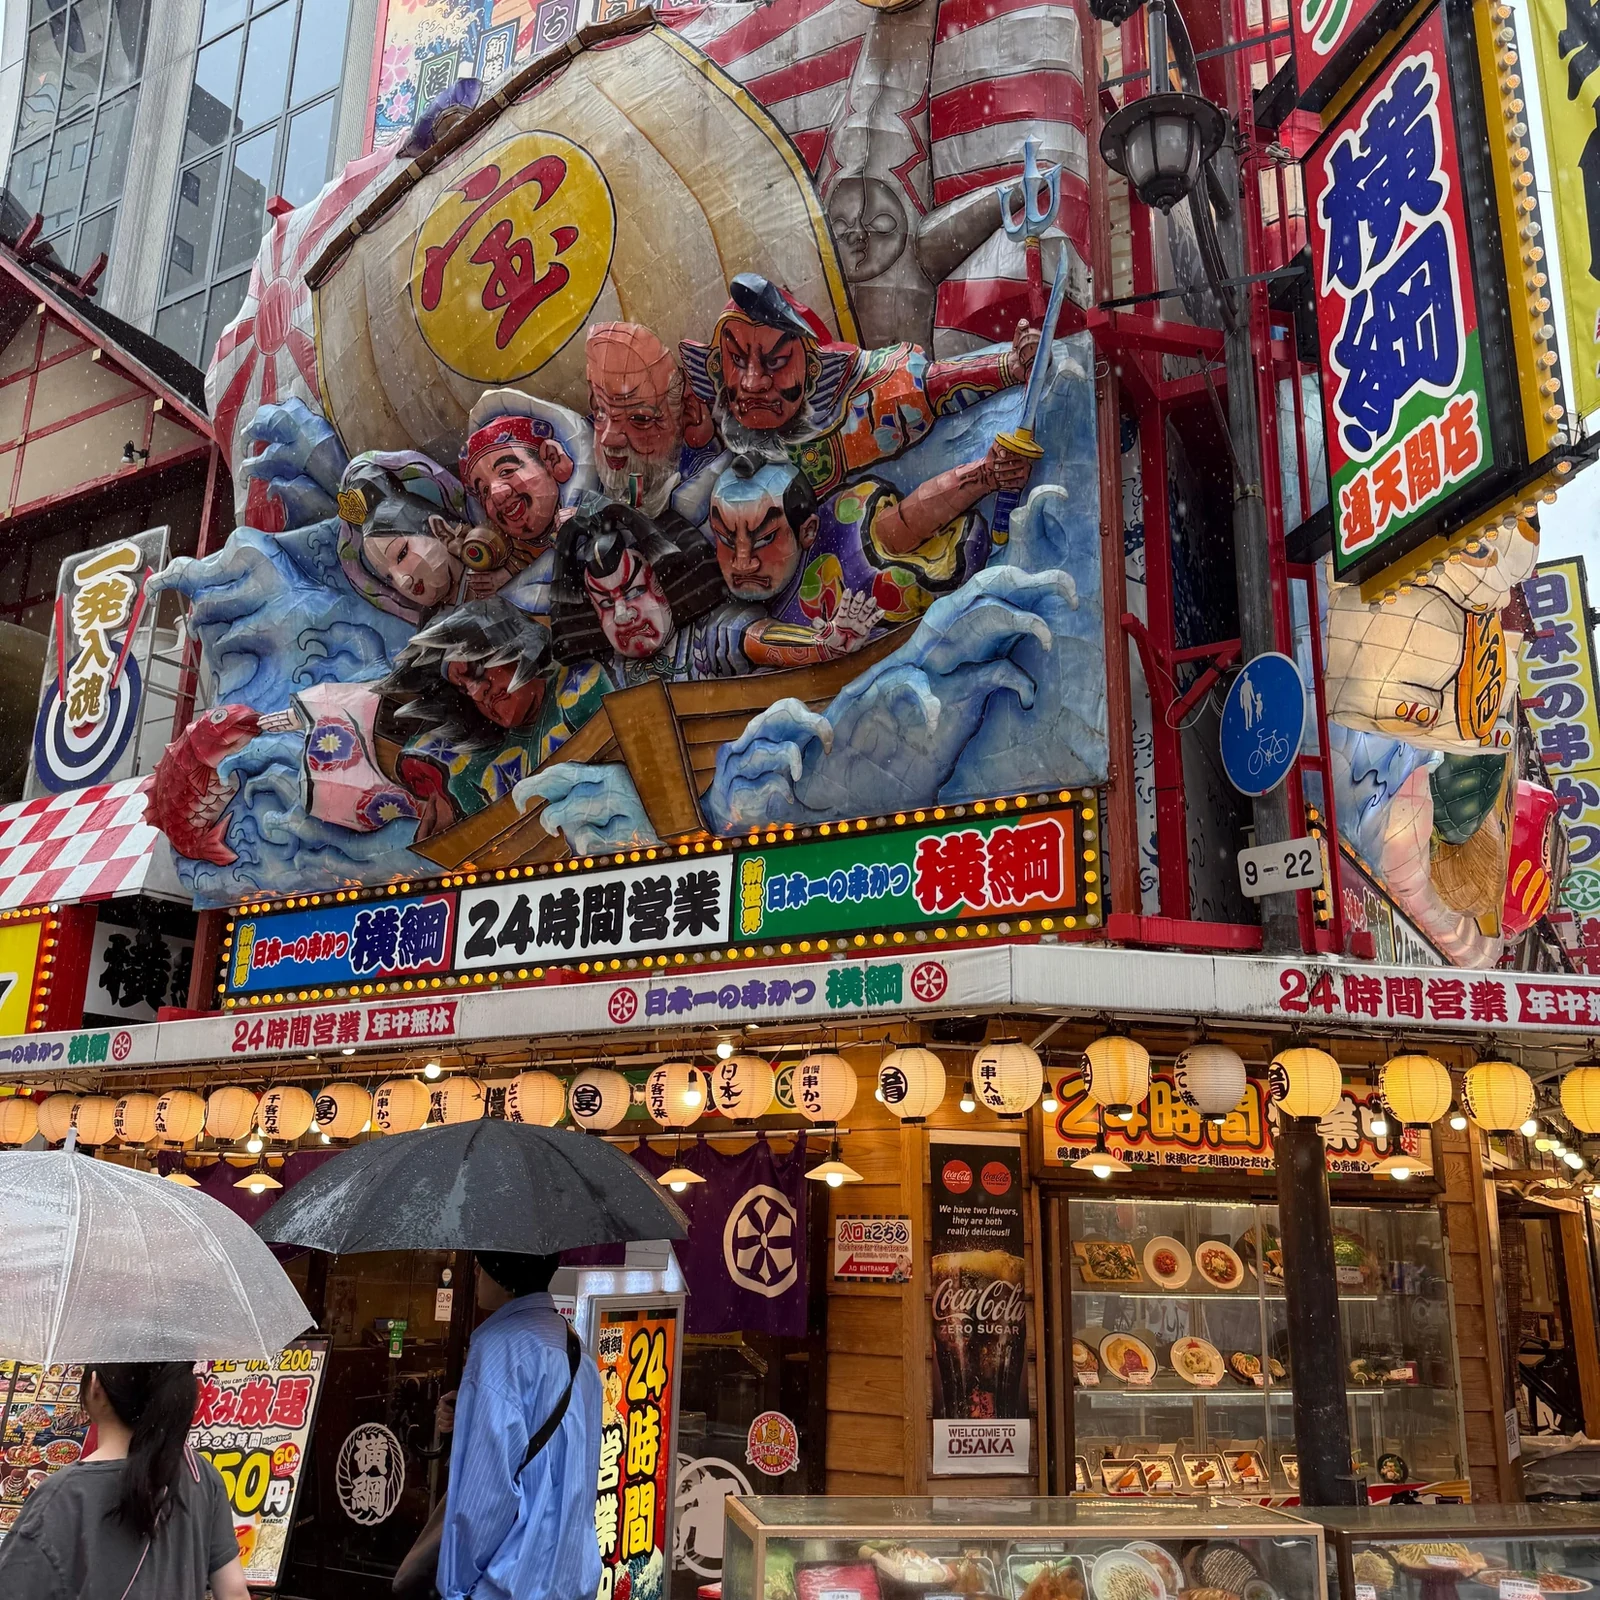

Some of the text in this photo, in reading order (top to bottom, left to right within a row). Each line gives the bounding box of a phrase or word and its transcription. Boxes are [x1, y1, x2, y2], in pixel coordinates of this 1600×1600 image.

[1322, 62, 1458, 452] 横綱
[1343, 398, 1478, 549] 通天閣店
[69, 546, 141, 719] 一発入魂
[1521, 572, 1600, 866] 日本一の串かつ
[767, 863, 911, 913] 日本一の串かつ
[914, 819, 1064, 914] 横綱
[464, 870, 721, 960] 24時間営業
[742, 857, 764, 934] 新世界
[234, 924, 254, 987] 新世界
[252, 930, 348, 969] 日本一の串かつ
[350, 899, 449, 973] 横綱
[644, 963, 904, 1016] 日本一の串かつ 横綱
[1279, 968, 1509, 1023] 24時間営業
[68, 1032, 110, 1064] 横綱
[231, 1004, 451, 1053] 24時間営業 年中無休
[575, 1087, 601, 1113] 宴
[650, 1070, 668, 1119] 千客万来
[719, 1063, 744, 1110] 日本一
[802, 1075, 821, 1113] 串かつ
[980, 1059, 1005, 1107] 一串入魂
[1175, 1053, 1199, 1107] どて焼
[154, 1097, 170, 1133] 一串入魂
[264, 1094, 281, 1135] 千客万来
[315, 1099, 336, 1123] 宴
[376, 1097, 391, 1129] 串かつ
[506, 1081, 524, 1124] どて焼
[939, 1205, 1018, 1216] We have two flavors,
[947, 1227, 1010, 1237] really delicious!!
[952, 1216, 969, 1226] they
[984, 1217, 1002, 1226] both
[838, 1221, 909, 1244] 入口はこちら
[932, 1278, 1025, 1322] Coca-Cola
[599, 1335, 623, 1355] 横綱
[940, 1325, 1020, 1335] ZERO SUGAR
[243, 1375, 258, 1383] drink
[279, 1349, 319, 1372] 200円
[188, 1433, 262, 1449] 只今のお時間
[621, 1328, 668, 1560] 24時間
[948, 1428, 1016, 1437] WELCOME TO
[948, 1438, 1015, 1454] OSAKA
[274, 1446, 300, 1465] 60分
[351, 1432, 389, 1517] 横綱
[198, 1451, 291, 1512] 50円
